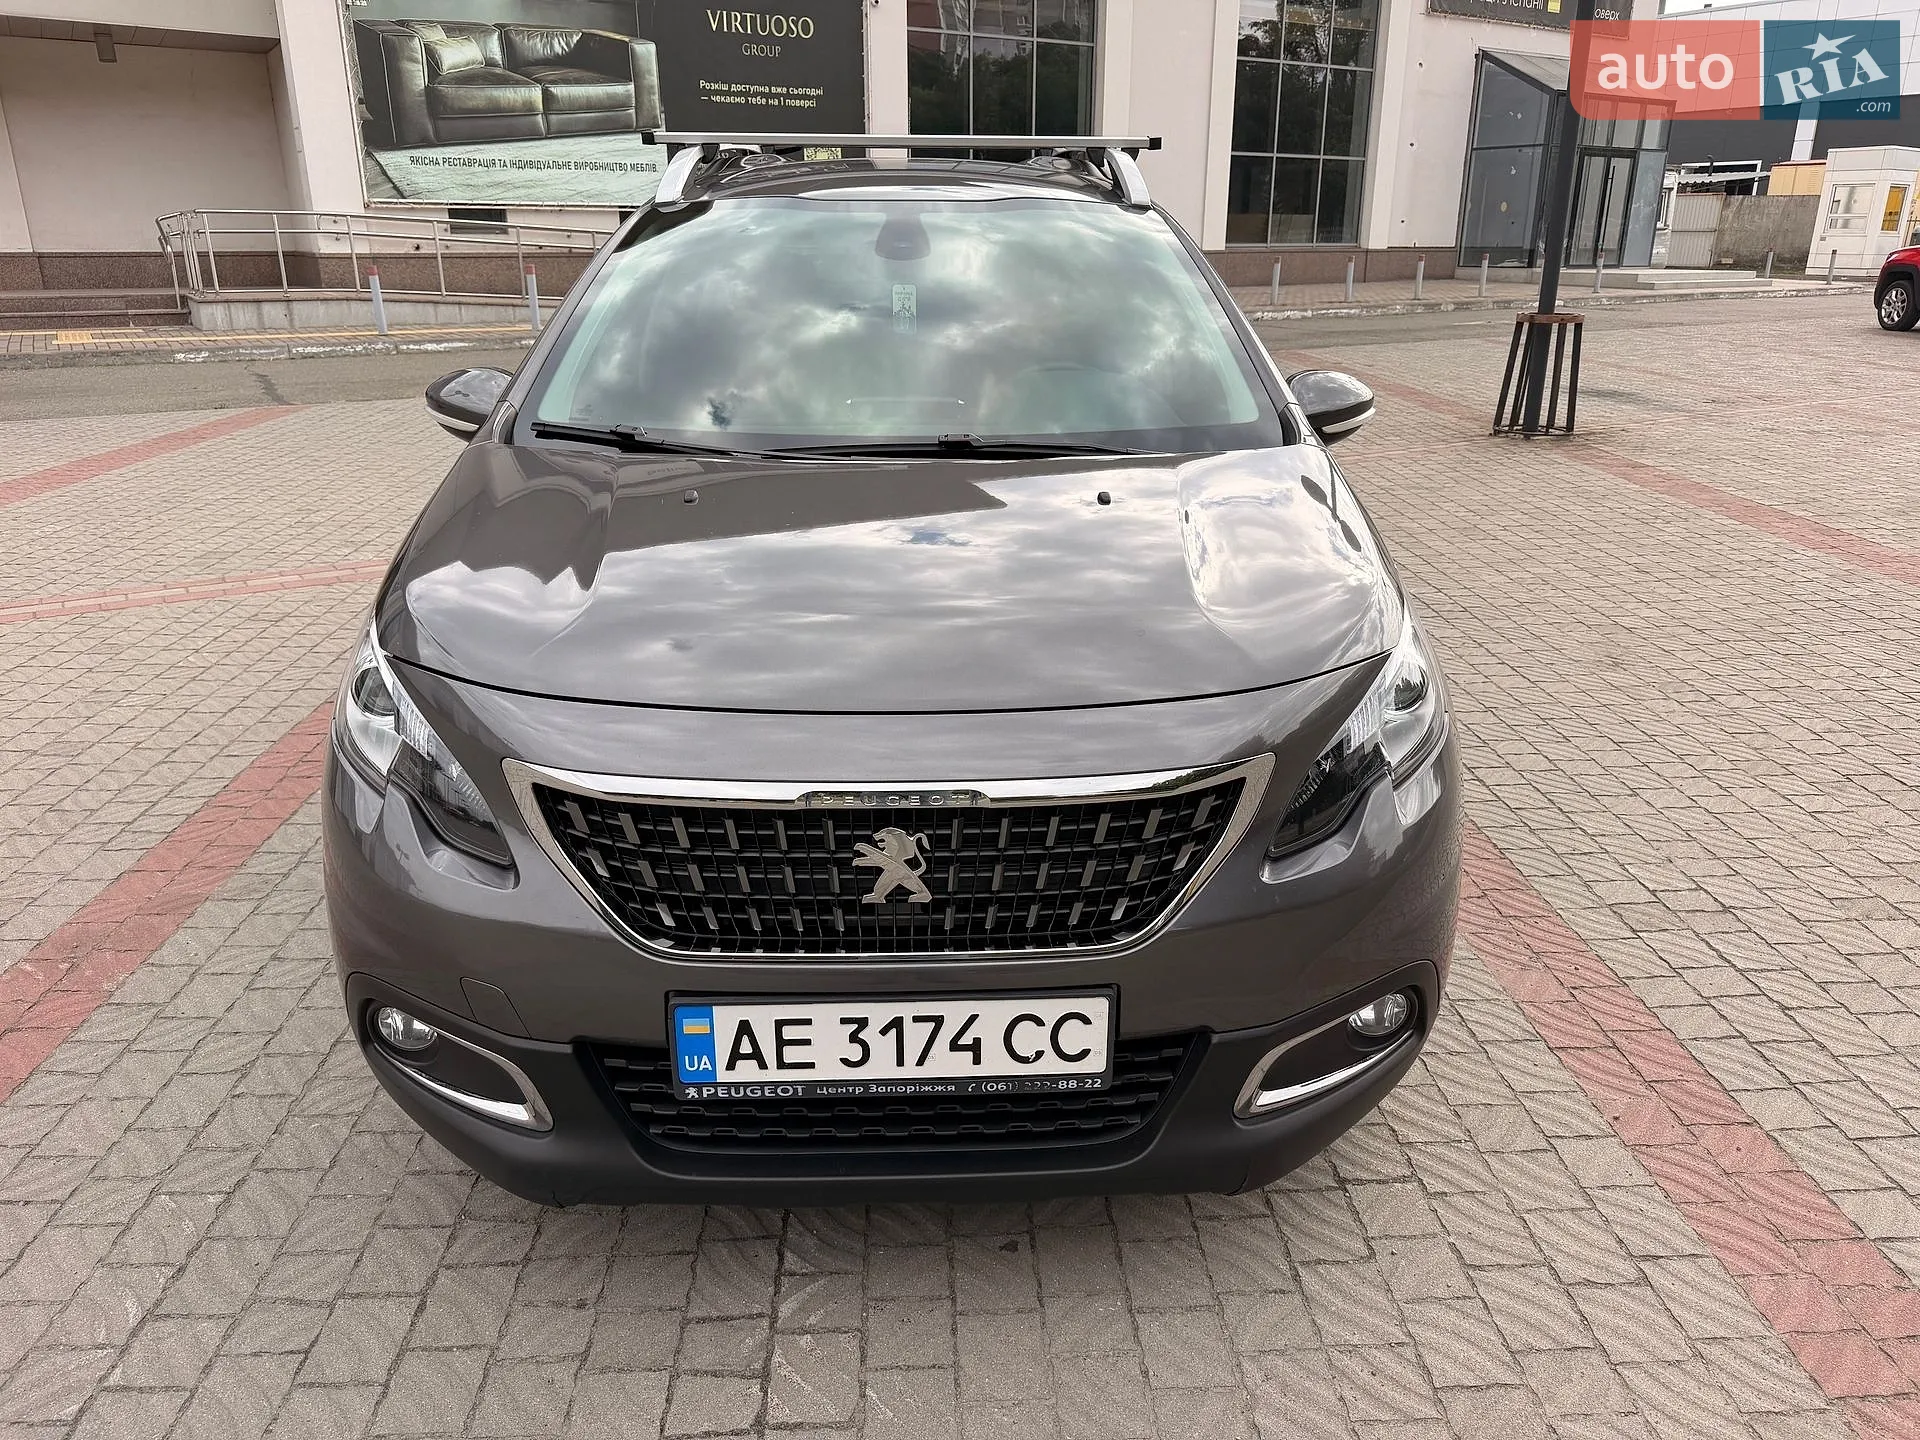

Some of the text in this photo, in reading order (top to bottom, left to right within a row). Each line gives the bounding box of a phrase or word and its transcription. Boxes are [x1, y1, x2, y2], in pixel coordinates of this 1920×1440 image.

[1594, 8, 1620, 22] оверх
[706, 9, 814, 38] VIRTUOSO
[742, 43, 781, 57] GROUP
[699, 79, 823, 96] Розкіш доступна вже сьогодні
[710, 94, 746, 104] чекаємо
[748, 96, 767, 105] тебе
[768, 98, 779, 106] на
[780, 98, 784, 106] 1
[785, 99, 816, 108] поверсі
[409, 155, 441, 167] ЯКІСНА
[442, 156, 497, 169] РЕСТАВРАЦІЯ
[498, 159, 508, 168] ТА
[509, 159, 572, 171] ІНДИВІДУАЛЬНЕ
[574, 161, 628, 173] ВИРОБНИЦТВО
[821, 794, 970, 806] PEUGEOT
[725, 1011, 1093, 1071] AE 3174 CC
[684, 1055, 713, 1071] UA
[702, 1084, 806, 1098] PEUGEOT
[816, 1085, 864, 1096] Центр
[868, 1082, 956, 1095] Запоріжжя
